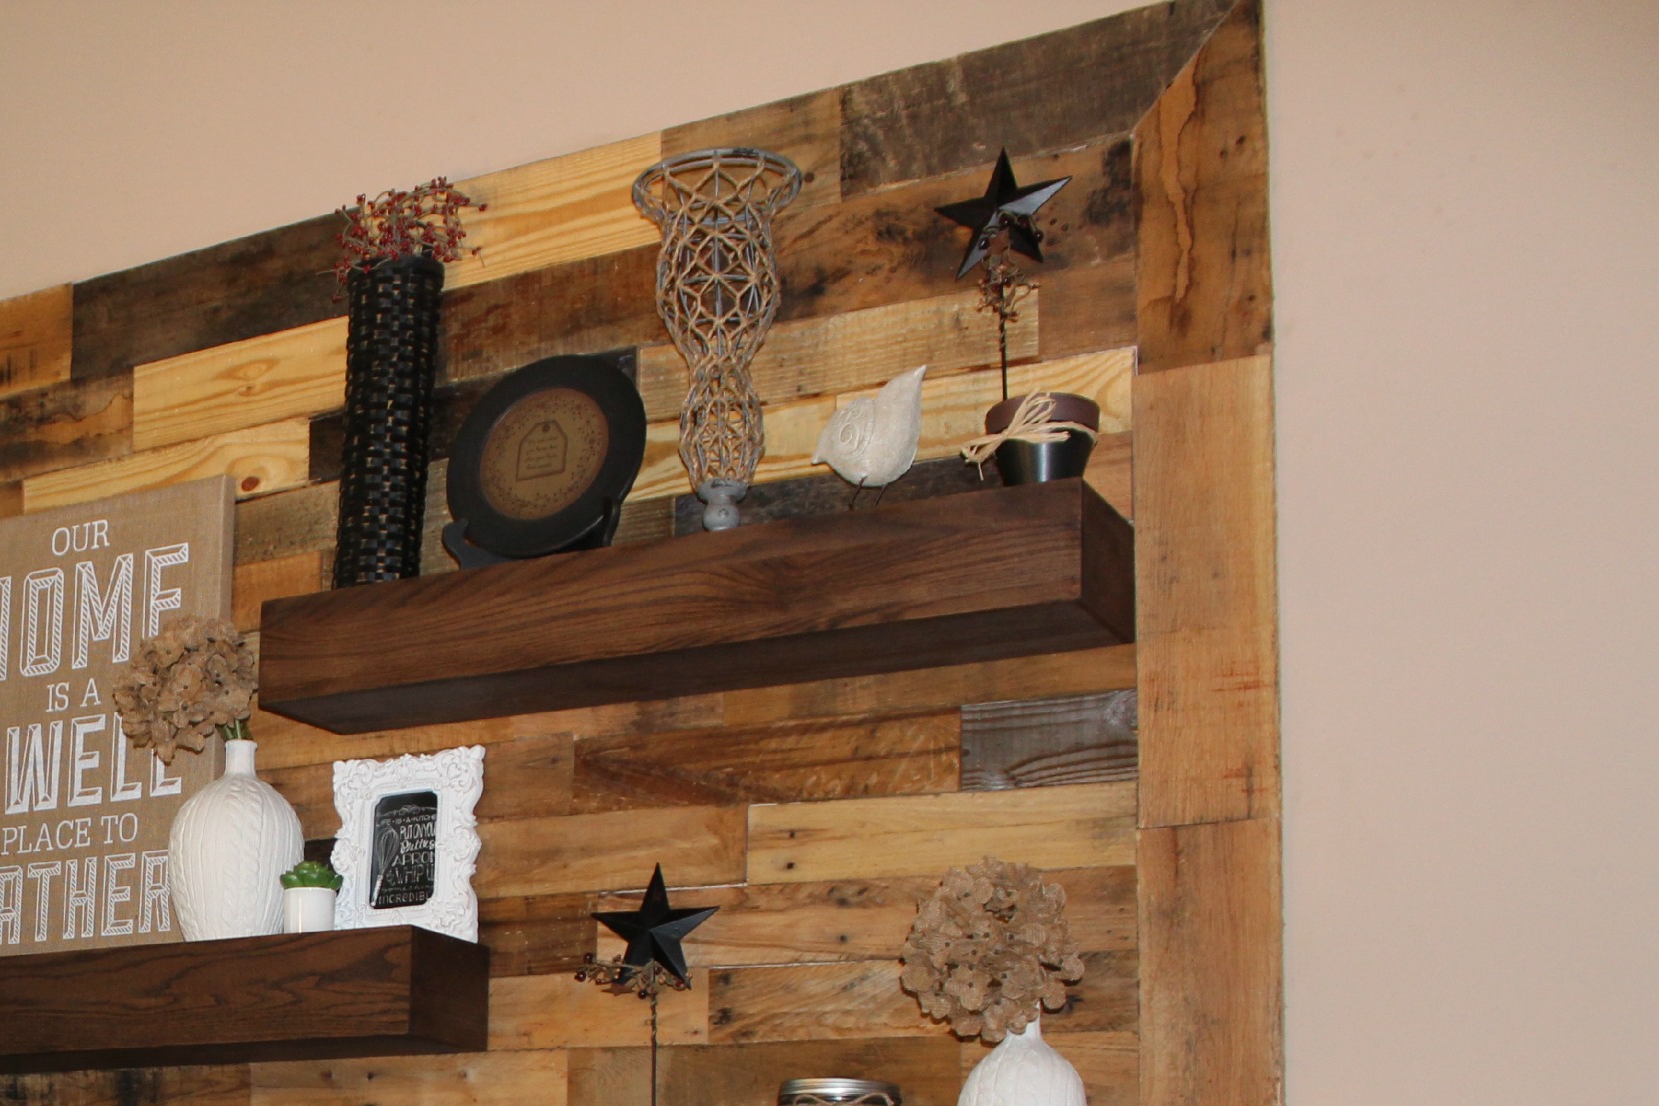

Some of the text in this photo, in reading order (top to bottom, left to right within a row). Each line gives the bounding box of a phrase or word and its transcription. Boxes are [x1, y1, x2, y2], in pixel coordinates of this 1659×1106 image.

[52, 519, 110, 556] OUR
[45, 678, 101, 712] IS A
[0, 812, 138, 856] PLACE TO
[426, 863, 435, 882] U
[378, 891, 429, 905] INCREDIBL
